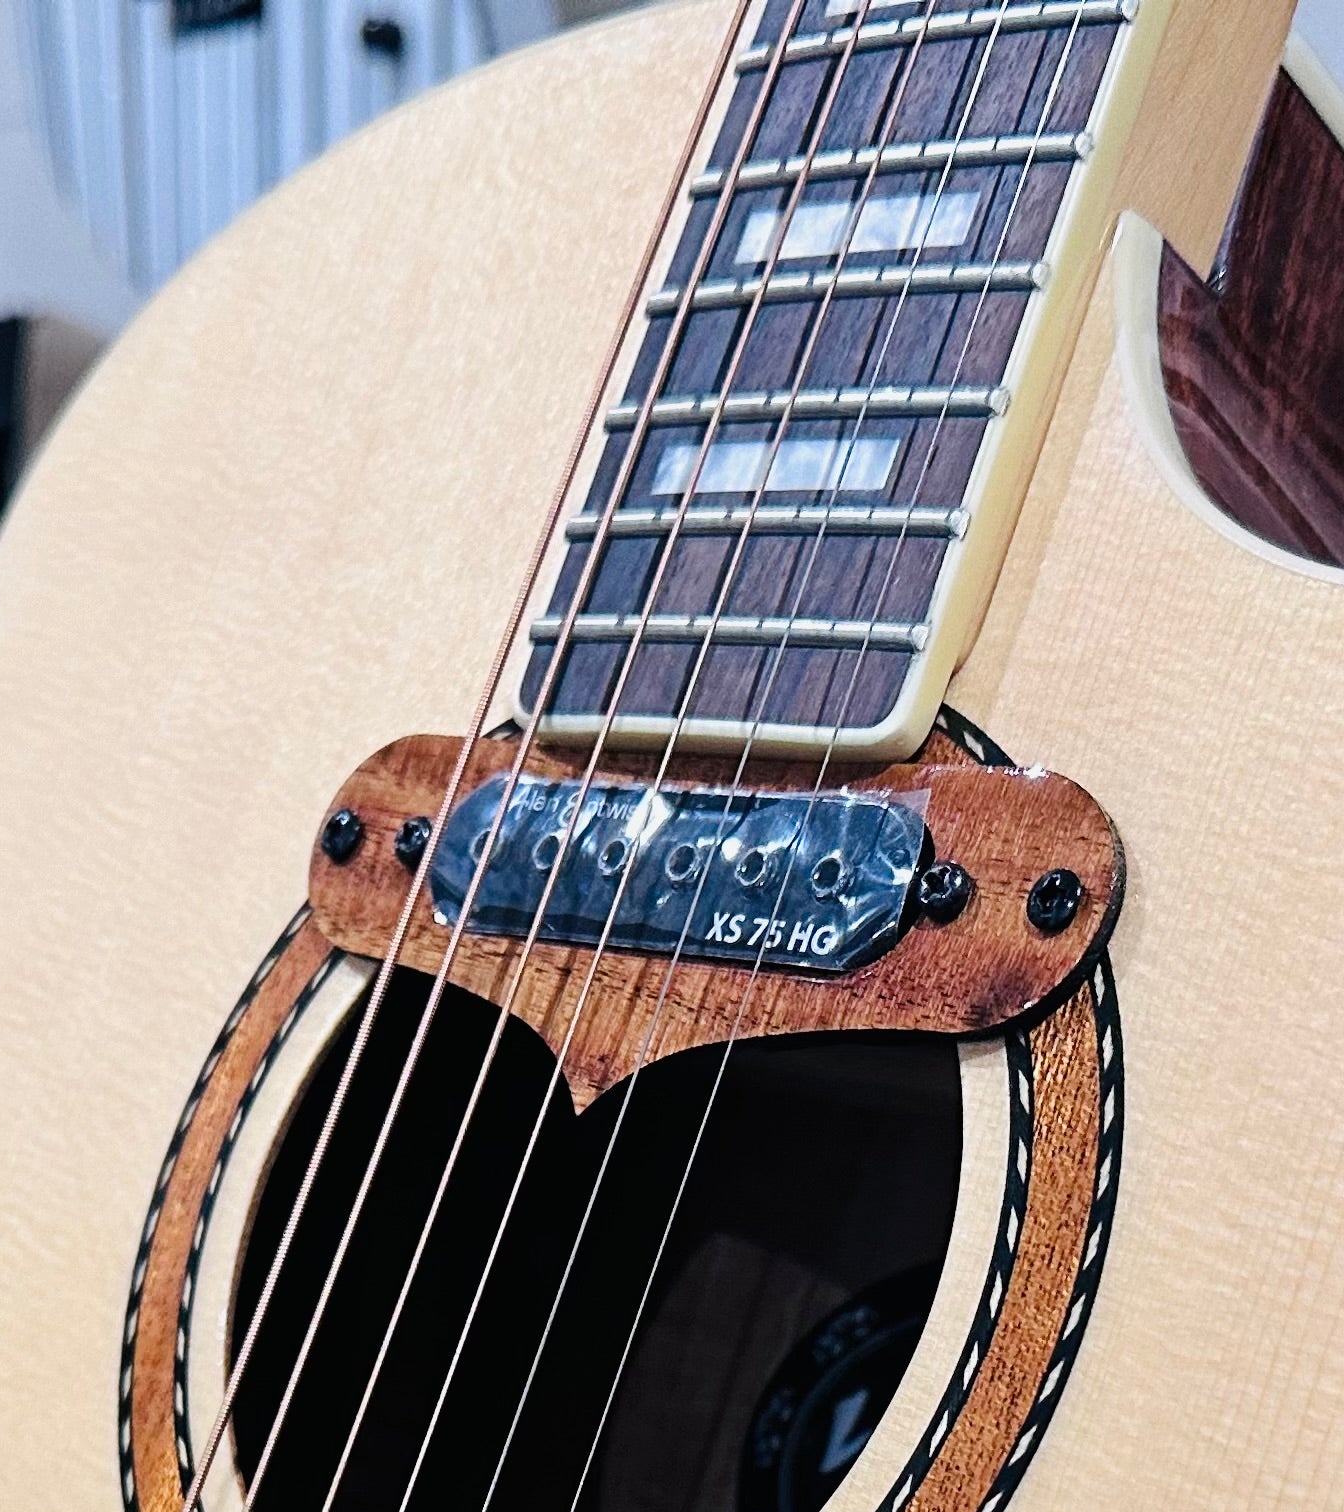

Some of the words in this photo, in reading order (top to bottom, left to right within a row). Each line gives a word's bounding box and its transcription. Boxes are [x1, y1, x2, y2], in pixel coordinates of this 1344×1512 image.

[705, 912, 746, 944] XS
[747, 917, 786, 949] 75
[786, 921, 838, 956] HG
